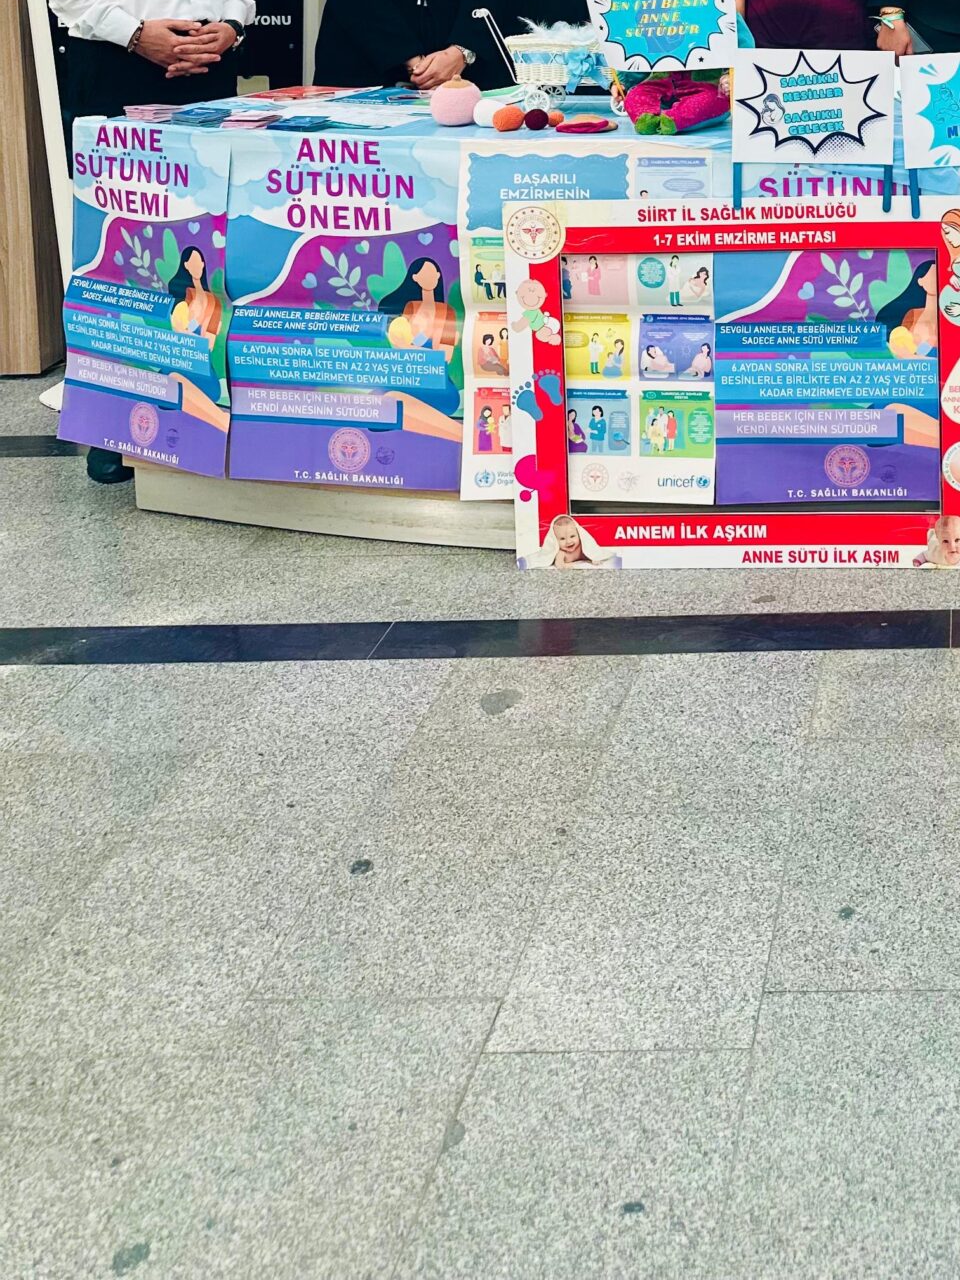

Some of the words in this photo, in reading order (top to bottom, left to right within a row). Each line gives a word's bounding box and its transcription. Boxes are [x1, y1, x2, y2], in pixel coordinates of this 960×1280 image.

[611, 2, 629, 10] EN
[254, 15, 291, 25] YONU
[640, 12, 680, 23] ANNE
[626, 22, 699, 37] SÜTÜDÜR
[780, 73, 838, 88] SAĞLIKLI
[783, 87, 843, 102] NESİLLER
[784, 109, 842, 124] SAĞLIKLI
[788, 121, 844, 135] GELECEK
[96, 125, 163, 153] ANNE
[297, 138, 381, 165] ANNE
[75, 148, 189, 187] SÜTÜNÜN
[266, 164, 414, 199] SÜTÜNÜN
[513, 173, 577, 186] BAŞARILI
[759, 171, 922, 197] SÜTÜN
[95, 180, 169, 218] ÖNEMİ
[500, 187, 590, 199] EMZİRMENİN
[287, 197, 391, 231] ÖNEMİ
[638, 206, 677, 222] SİİRT
[682, 205, 695, 221] İL
[701, 204, 755, 221] SAĞLIK
[761, 202, 857, 219] MÜDÜRLÜĞÜ
[653, 234, 672, 246] 1-7
[677, 231, 710, 246] EKİM
[715, 230, 776, 245] EMZİRME
[780, 230, 836, 243] HAFTASI
[721, 325, 751, 333] SEVGİLİ
[753, 326, 795, 334] ANNELER,
[798, 324, 846, 333] BEBEĞİNİZE
[848, 324, 861, 333] İLK
[802, 335, 823, 344] SÜTÜ
[826, 335, 857, 344] VERİNİZ
[242, 346, 279, 355] 6.AYDAN
[282, 348, 312, 356] SONRA
[315, 348, 329, 357] İSE
[332, 350, 362, 359] UYGUN
[365, 352, 426, 362] TAMAMLAYICI
[235, 356, 289, 367] BESİNLERLE
[293, 358, 333, 369] BİRLİKTE
[336, 362, 348, 370] EN
[351, 362, 362, 370] AZ
[365, 363, 370, 371] 2
[372, 363, 389, 373] YAŞ
[392, 364, 402, 372] VE
[406, 363, 444, 375] ÖTESİNE
[732, 363, 772, 372] 6.AYDAN
[775, 363, 808, 372] SONRA
[812, 361, 826, 372] İSE
[830, 363, 862, 371] UYGUN
[866, 363, 930, 371] TAMAMLAYICI
[722, 374, 783, 384] BESİNLERLE
[787, 374, 830, 384] BİRLİKTE
[834, 376, 847, 384] EN
[850, 376, 862, 384] AZ
[865, 376, 870, 384] 2
[873, 375, 891, 386] YAŞ
[894, 375, 906, 384] VE
[909, 373, 937, 384] ÖTESİ
[760, 388, 793, 397] KADAR
[797, 386, 852, 397] EMZİRMEYE
[855, 388, 889, 397] DEVAM
[893, 386, 924, 396] EDİNİZ
[250, 402, 279, 413] KENDİ
[282, 404, 332, 415] ANNESİNİN
[336, 406, 378, 418] SÜTÜDÜR
[733, 412, 754, 421] HER
[757, 412, 790, 421] BEBEK
[795, 410, 815, 422] İÇİN
[818, 412, 832, 420] EN
[836, 409, 847, 420] İYİ
[850, 409, 880, 420] BESİN
[737, 423, 768, 434] KENDİ
[770, 423, 827, 434] ANNESİNİN
[831, 423, 877, 433] SÜTÜDÜR
[104, 438, 116, 448] T.C.
[118, 441, 141, 454] SAĞLIK
[143, 448, 179, 464] BAKANLIĞI
[295, 471, 311, 479] T.C.
[315, 470, 349, 481] SAĞLIK
[352, 474, 403, 485] BAKANLIĞI
[657, 475, 695, 489] unicef
[788, 490, 807, 498] T.C.
[811, 487, 847, 497] SAĞLIK
[852, 487, 907, 497] BAKANLIĞI
[615, 526, 675, 540] ANNEM
[681, 522, 707, 539] İLK
[713, 525, 767, 541] AŞKIM
[742, 550, 783, 564] ANNE
[788, 547, 828, 564] SÜTÜ
[834, 546, 858, 563] İLK
[863, 550, 899, 566] AŞIM
